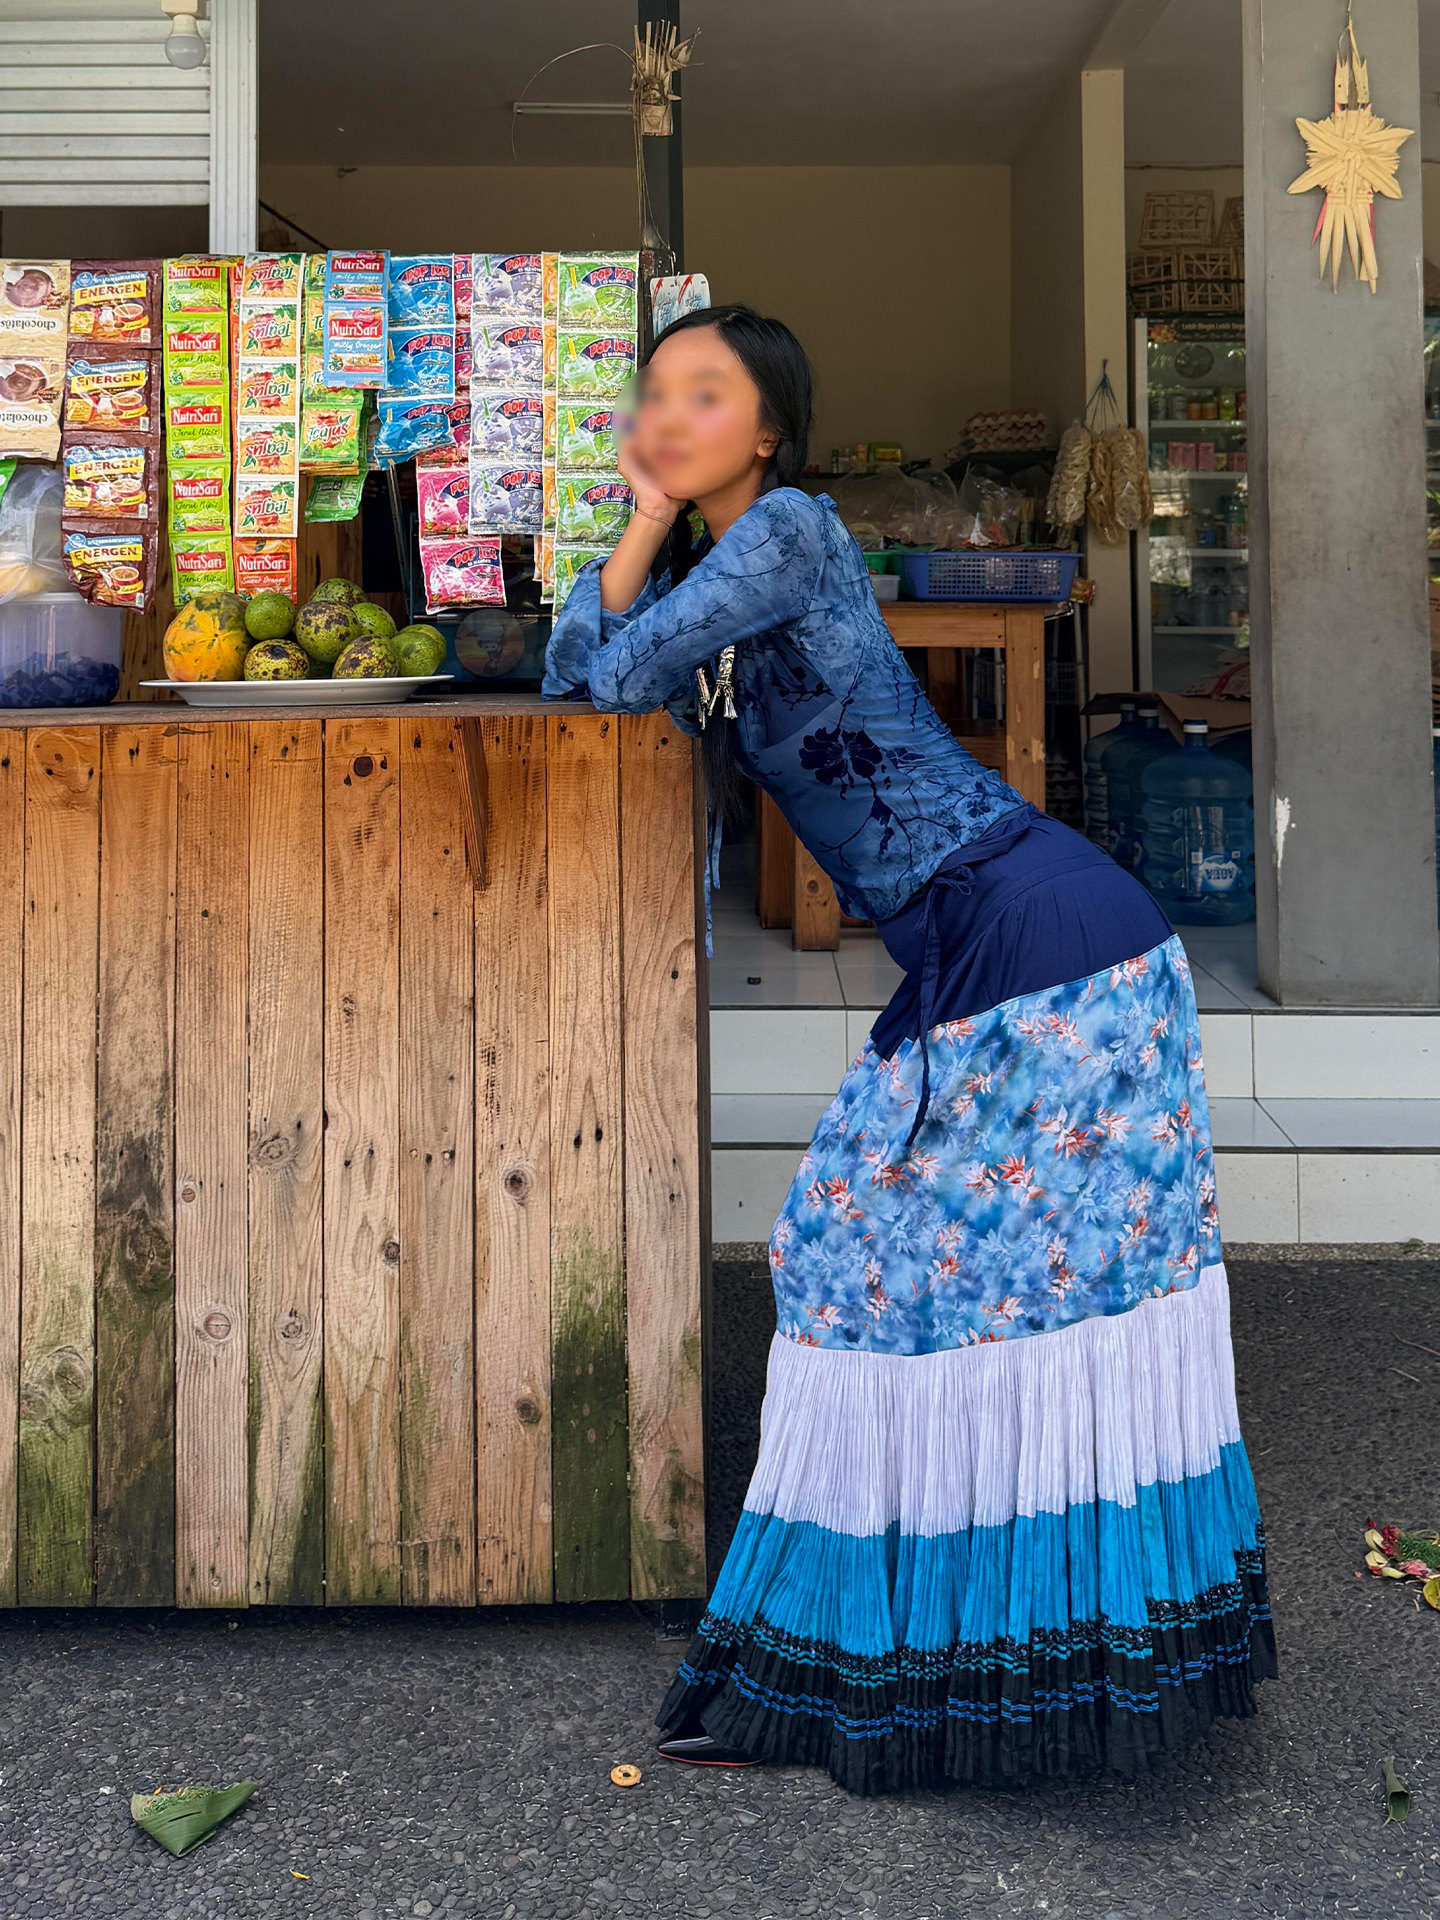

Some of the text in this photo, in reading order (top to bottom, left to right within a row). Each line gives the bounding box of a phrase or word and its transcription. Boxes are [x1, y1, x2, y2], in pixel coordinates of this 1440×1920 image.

[171, 265, 216, 278] NutriSari
[334, 259, 380, 271] NutriSari
[505, 255, 541, 273] POP IC
[335, 272, 379, 281] Milky Orange
[405, 265, 428, 284] POP
[431, 264, 450, 278] ICE
[590, 267, 634, 286] POP ICE
[79, 283, 143, 300] ENERGEN
[331, 321, 378, 336] NutriSari
[504, 327, 542, 347] POP IC
[170, 334, 216, 350] NutriSari
[333, 343, 380, 351] Milky Orange
[408, 334, 451, 354] POP ICE
[589, 339, 633, 358] POP ICE
[76, 372, 142, 388] ENERGEN
[173, 407, 218, 424] NutriSari
[449, 406, 469, 424] POP
[503, 398, 542, 416] POP IC
[0, 413, 48, 425] chocolat
[588, 412, 610, 430] POP
[174, 429, 196, 437] Jeruk
[74, 458, 140, 476] ENERGEN
[502, 471, 541, 489] POP IC
[175, 481, 218, 497] NutriSari
[587, 483, 631, 504] POP ICE
[74, 546, 138, 561] ENERGEN
[453, 547, 497, 567] POP ICE
[177, 555, 222, 570] NutriSari
[239, 555, 286, 571] NutriSari
[1205, 867, 1234, 880] AQUA
